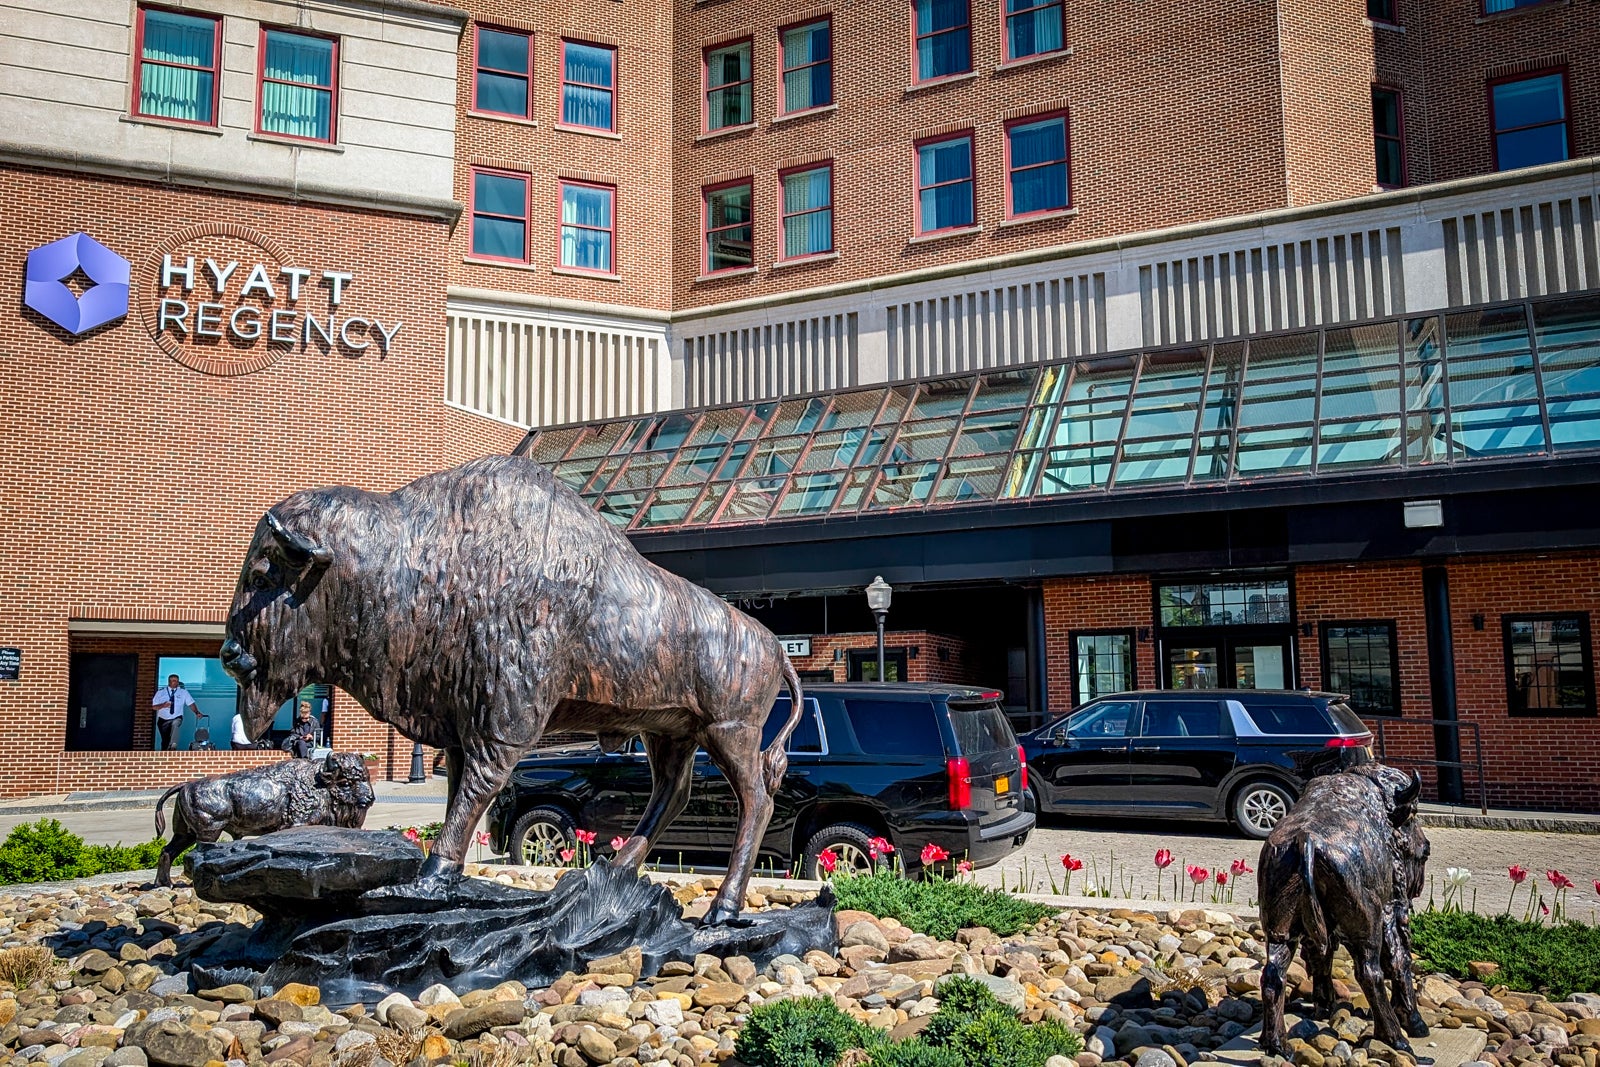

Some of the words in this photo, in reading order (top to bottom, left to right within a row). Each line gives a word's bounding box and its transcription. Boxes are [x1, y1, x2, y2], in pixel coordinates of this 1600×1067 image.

[162, 254, 353, 304] HYATT
[159, 298, 403, 351] REGENCY
[784, 642, 803, 653] ET
